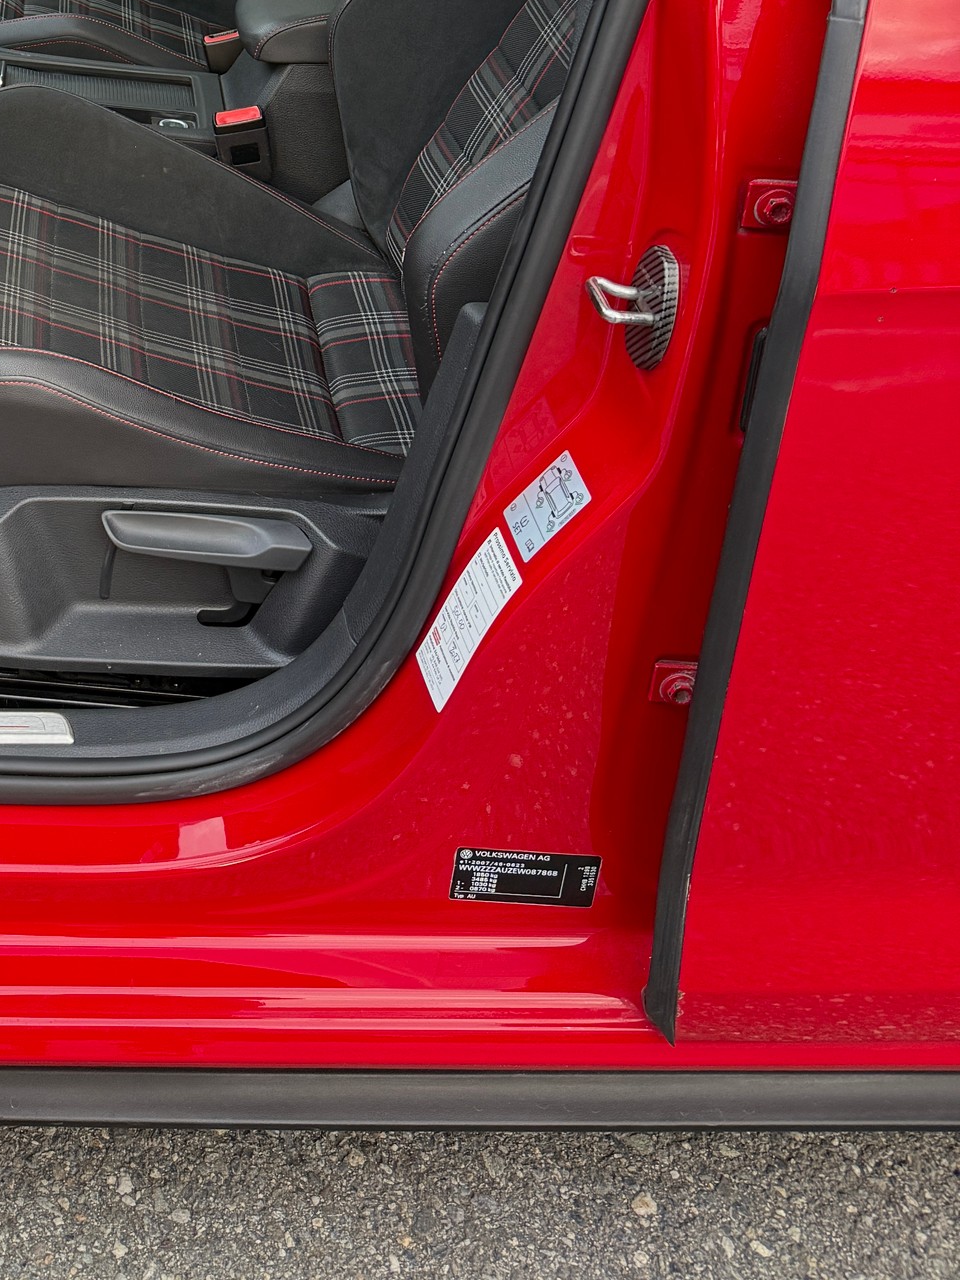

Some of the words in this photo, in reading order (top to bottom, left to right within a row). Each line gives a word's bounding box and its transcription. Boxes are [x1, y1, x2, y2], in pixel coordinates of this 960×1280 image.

[511, 521, 522, 535] SET
[492, 532, 506, 558] Prossimo
[503, 557, 517, 581] Servizio
[475, 850, 536, 861] VOLKSWAGEN
